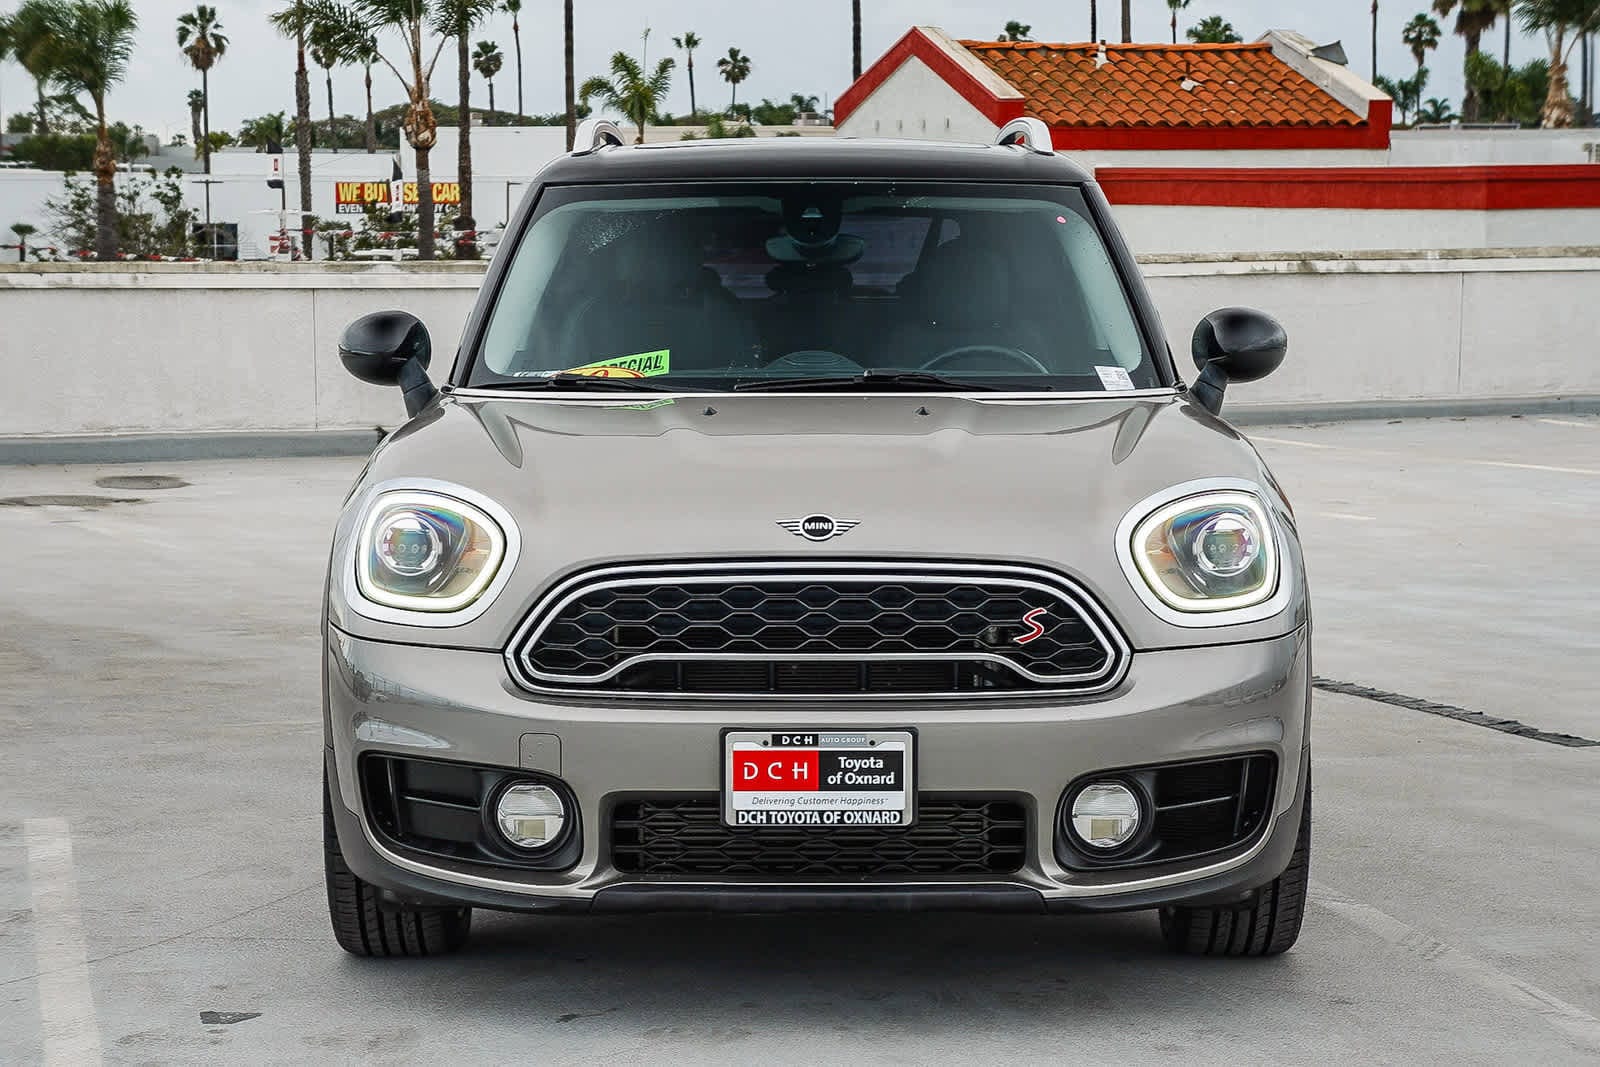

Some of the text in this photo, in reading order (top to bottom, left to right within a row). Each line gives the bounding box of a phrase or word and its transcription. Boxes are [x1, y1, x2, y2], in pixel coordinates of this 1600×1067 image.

[338, 183, 361, 202] WE
[601, 354, 664, 373] CIAL
[804, 522, 833, 530] MINI
[1013, 607, 1048, 645] S
[781, 735, 813, 745] DCH
[838, 756, 884, 771] Toyota
[743, 762, 809, 780] DCH
[827, 771, 895, 785] of Oxnard
[751, 796, 796, 807] Delivering
[797, 796, 839, 806] Customer
[738, 811, 900, 824] DCH TOYOTA OF OXNARD
